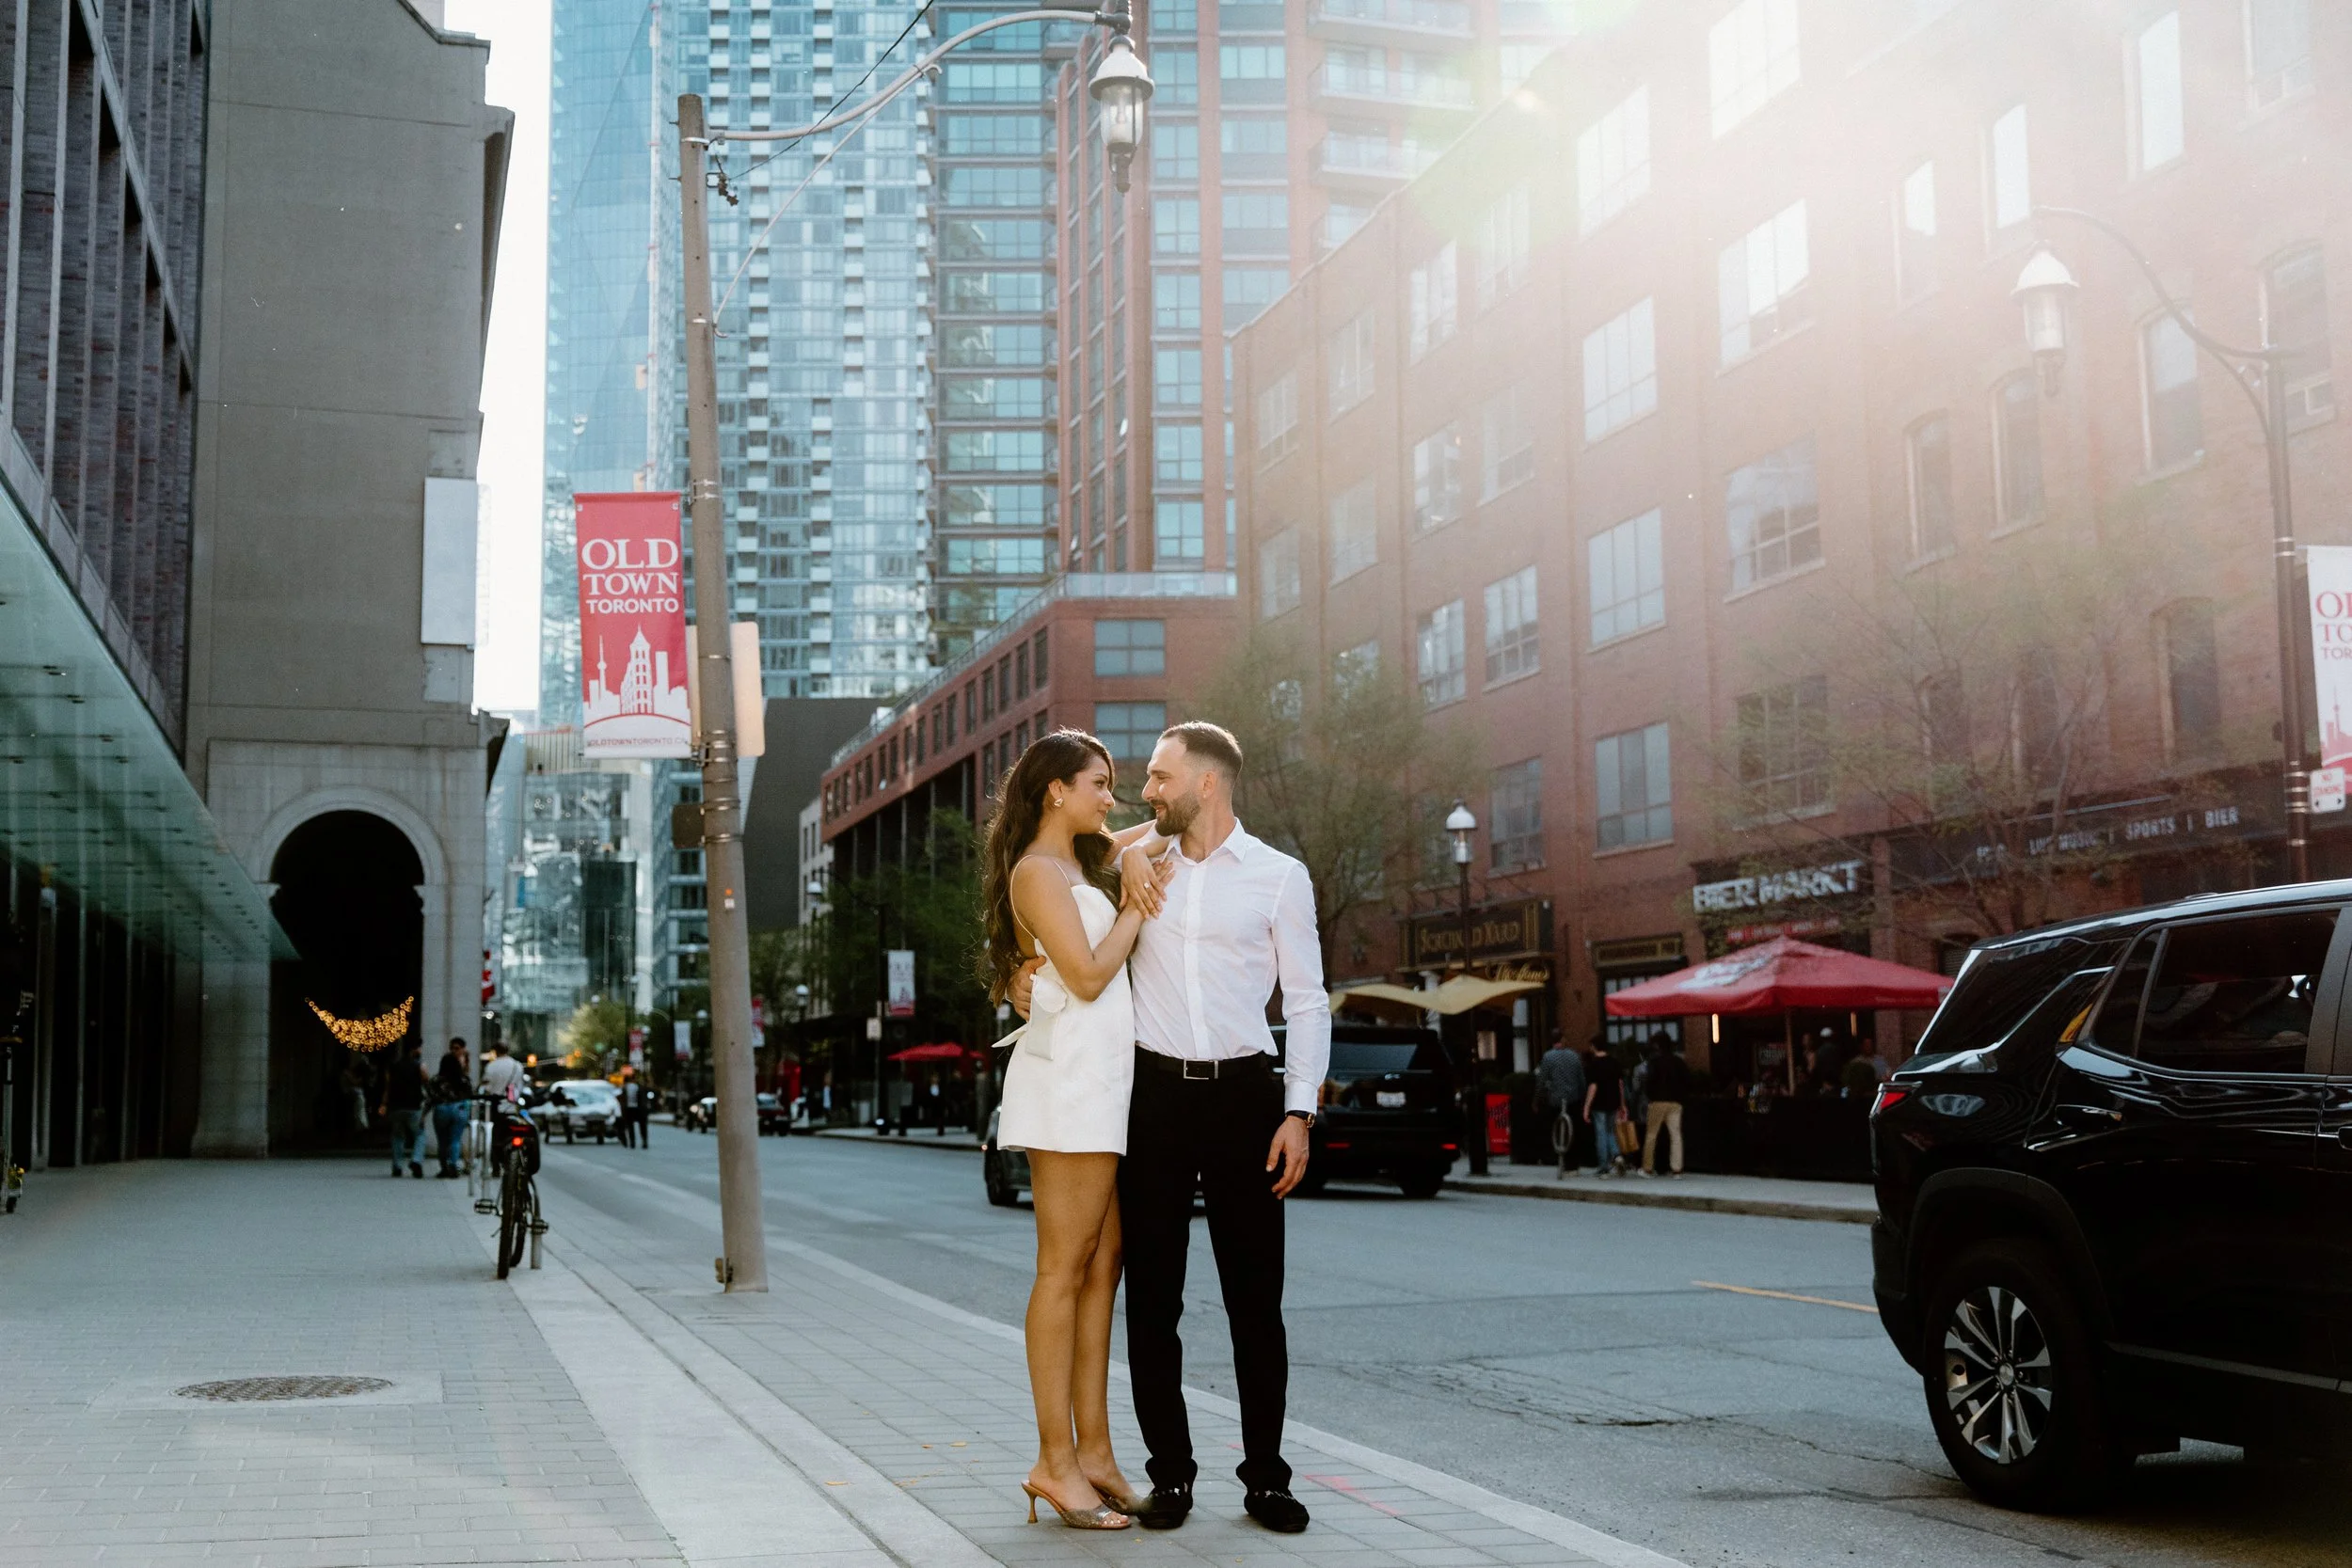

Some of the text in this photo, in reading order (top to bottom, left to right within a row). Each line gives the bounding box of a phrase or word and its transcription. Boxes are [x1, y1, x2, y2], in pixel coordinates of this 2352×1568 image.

[581, 538, 678, 570] OLD
[582, 572, 678, 595] TOWN
[586, 597, 679, 614] TORONTO
[2125, 816, 2178, 841] SPORTS
[2204, 806, 2239, 829] BIER
[1693, 859, 1865, 913] BIER MARKT
